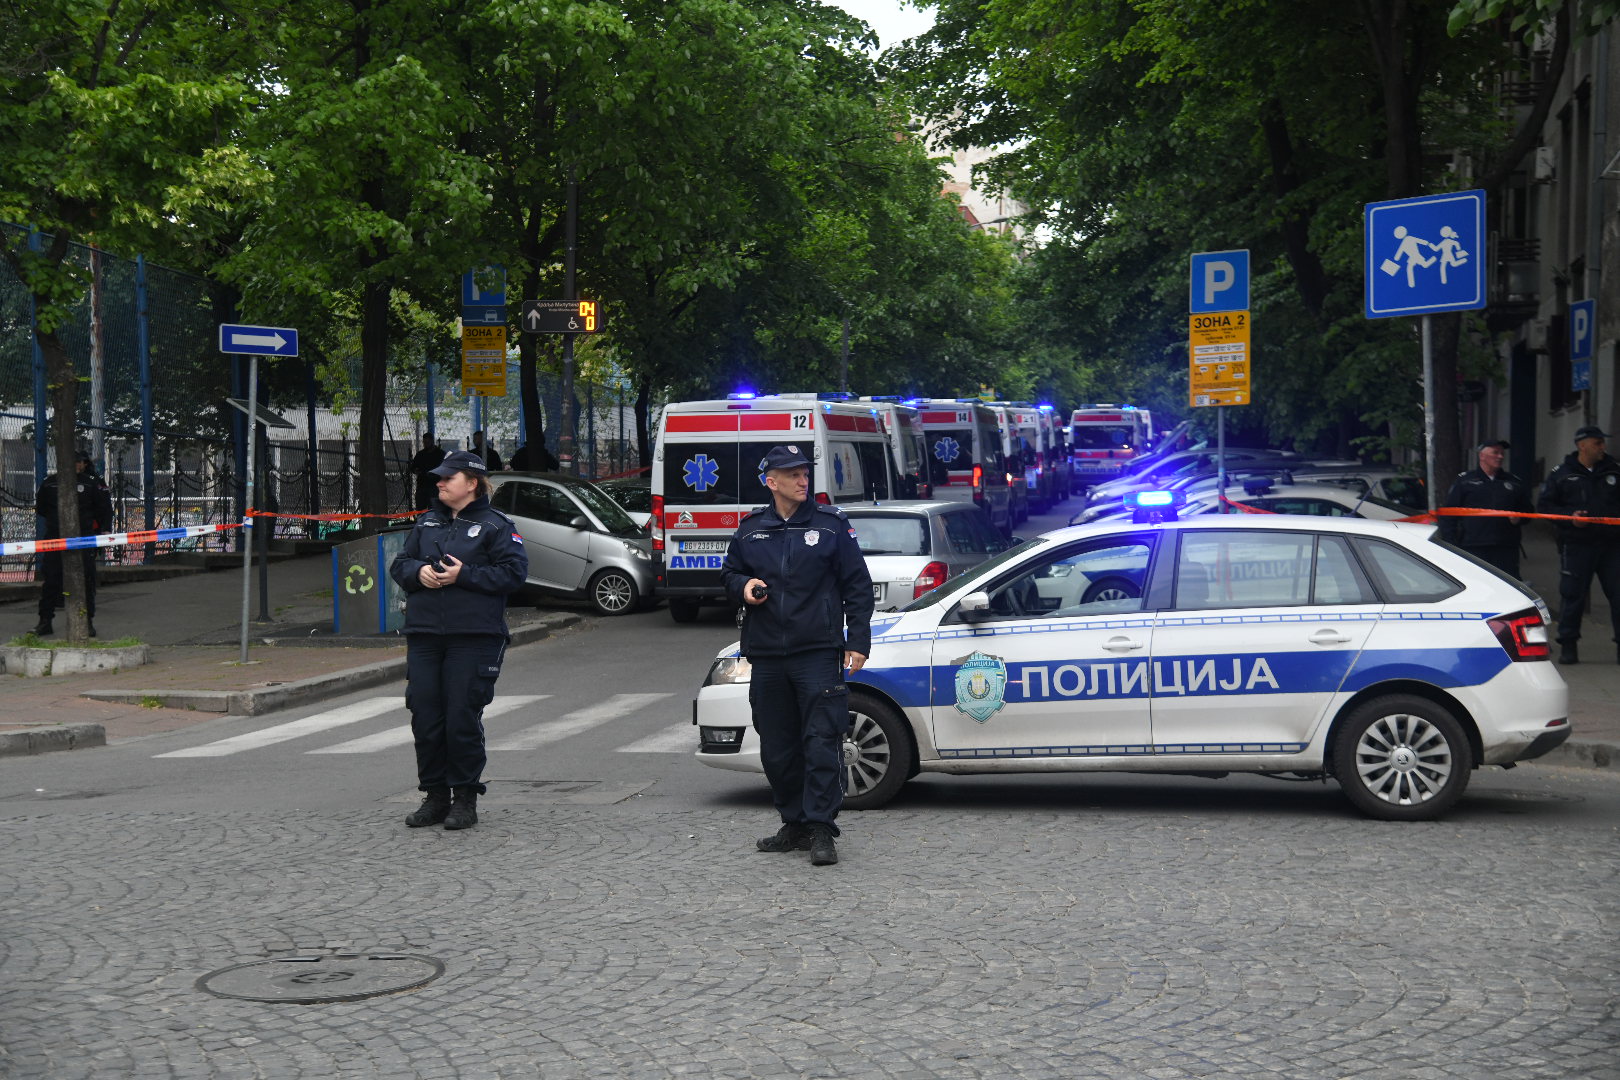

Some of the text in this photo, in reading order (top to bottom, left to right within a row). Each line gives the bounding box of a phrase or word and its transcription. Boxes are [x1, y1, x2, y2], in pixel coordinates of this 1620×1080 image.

[1204, 260, 1234, 304] P
[579, 301, 595, 316] 04
[1194, 314, 1245, 328] ЗОНА 2
[465, 328, 503, 337] ЗОНА 2
[1574, 308, 1588, 353] P
[792, 415, 807, 428] 12
[958, 413, 967, 421] 14
[670, 555, 727, 568] AMB
[1021, 658, 1280, 698] ПОЛИЦИЈА
